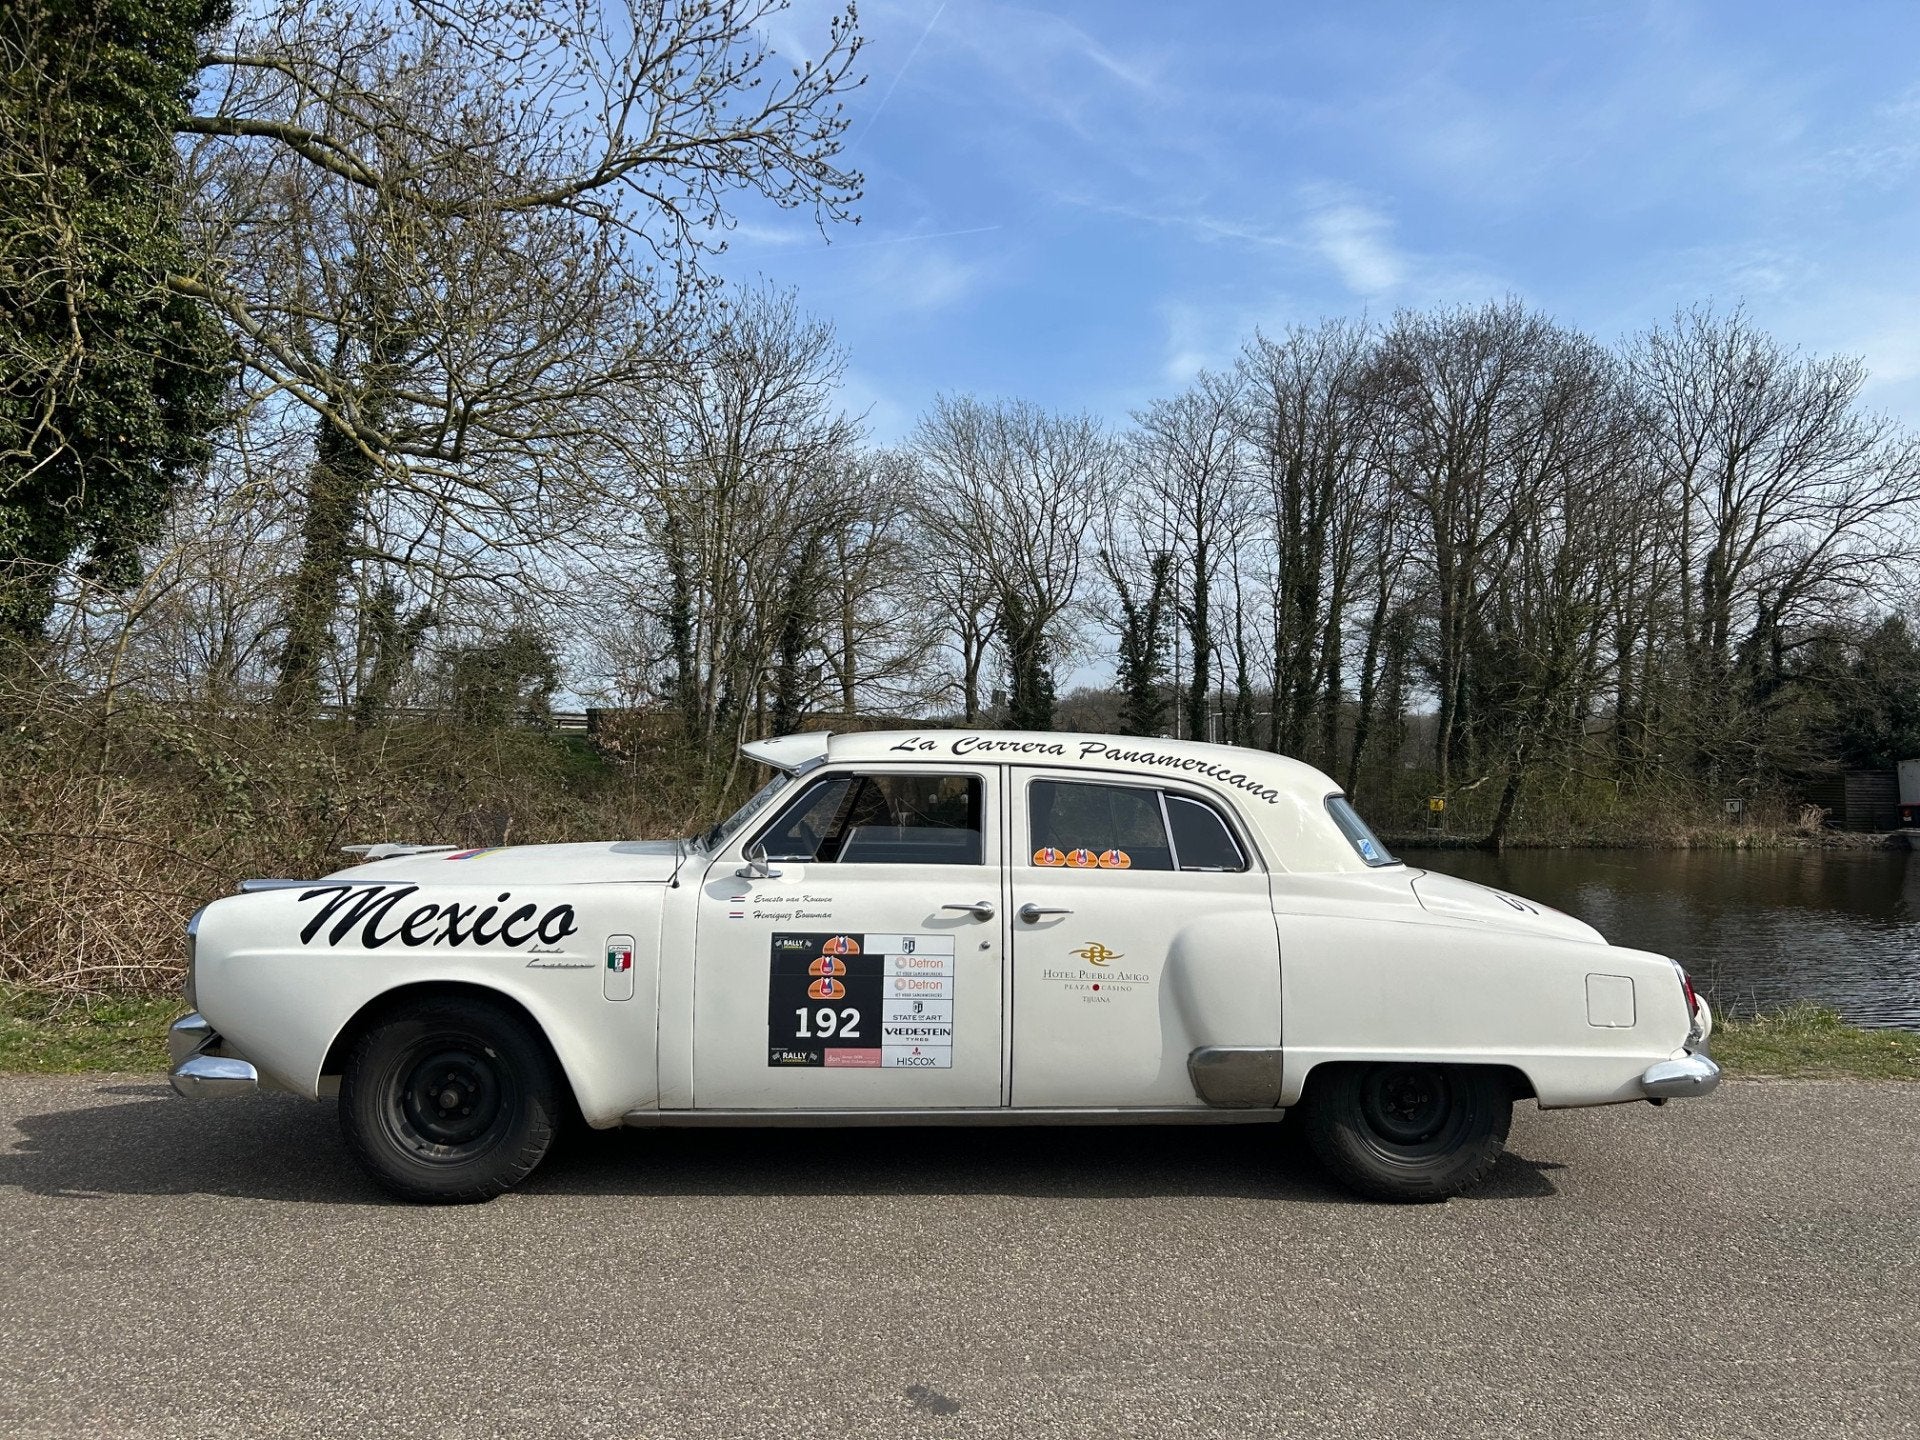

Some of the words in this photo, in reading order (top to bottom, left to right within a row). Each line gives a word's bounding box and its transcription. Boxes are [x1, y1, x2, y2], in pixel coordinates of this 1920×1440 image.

[890, 736, 938, 752] La
[951, 736, 1066, 756] Carrera
[1079, 741, 1280, 805] Panamericana
[754, 894, 784, 903] Ernesto
[298, 885, 578, 950] Mexico
[753, 910, 793, 921] Henriquez
[783, 939, 804, 948] RALLY
[908, 957, 944, 969] Detron
[1043, 969, 1076, 979] HOTEL
[1079, 970, 1115, 980] PUEBLO
[1117, 971, 1150, 982] AMIGO
[908, 979, 943, 990] Detron
[1101, 984, 1133, 992] CASINO
[795, 1007, 861, 1038] 192
[884, 1027, 951, 1036] VREDESTEIN
[896, 1057, 936, 1066] HISCOX
